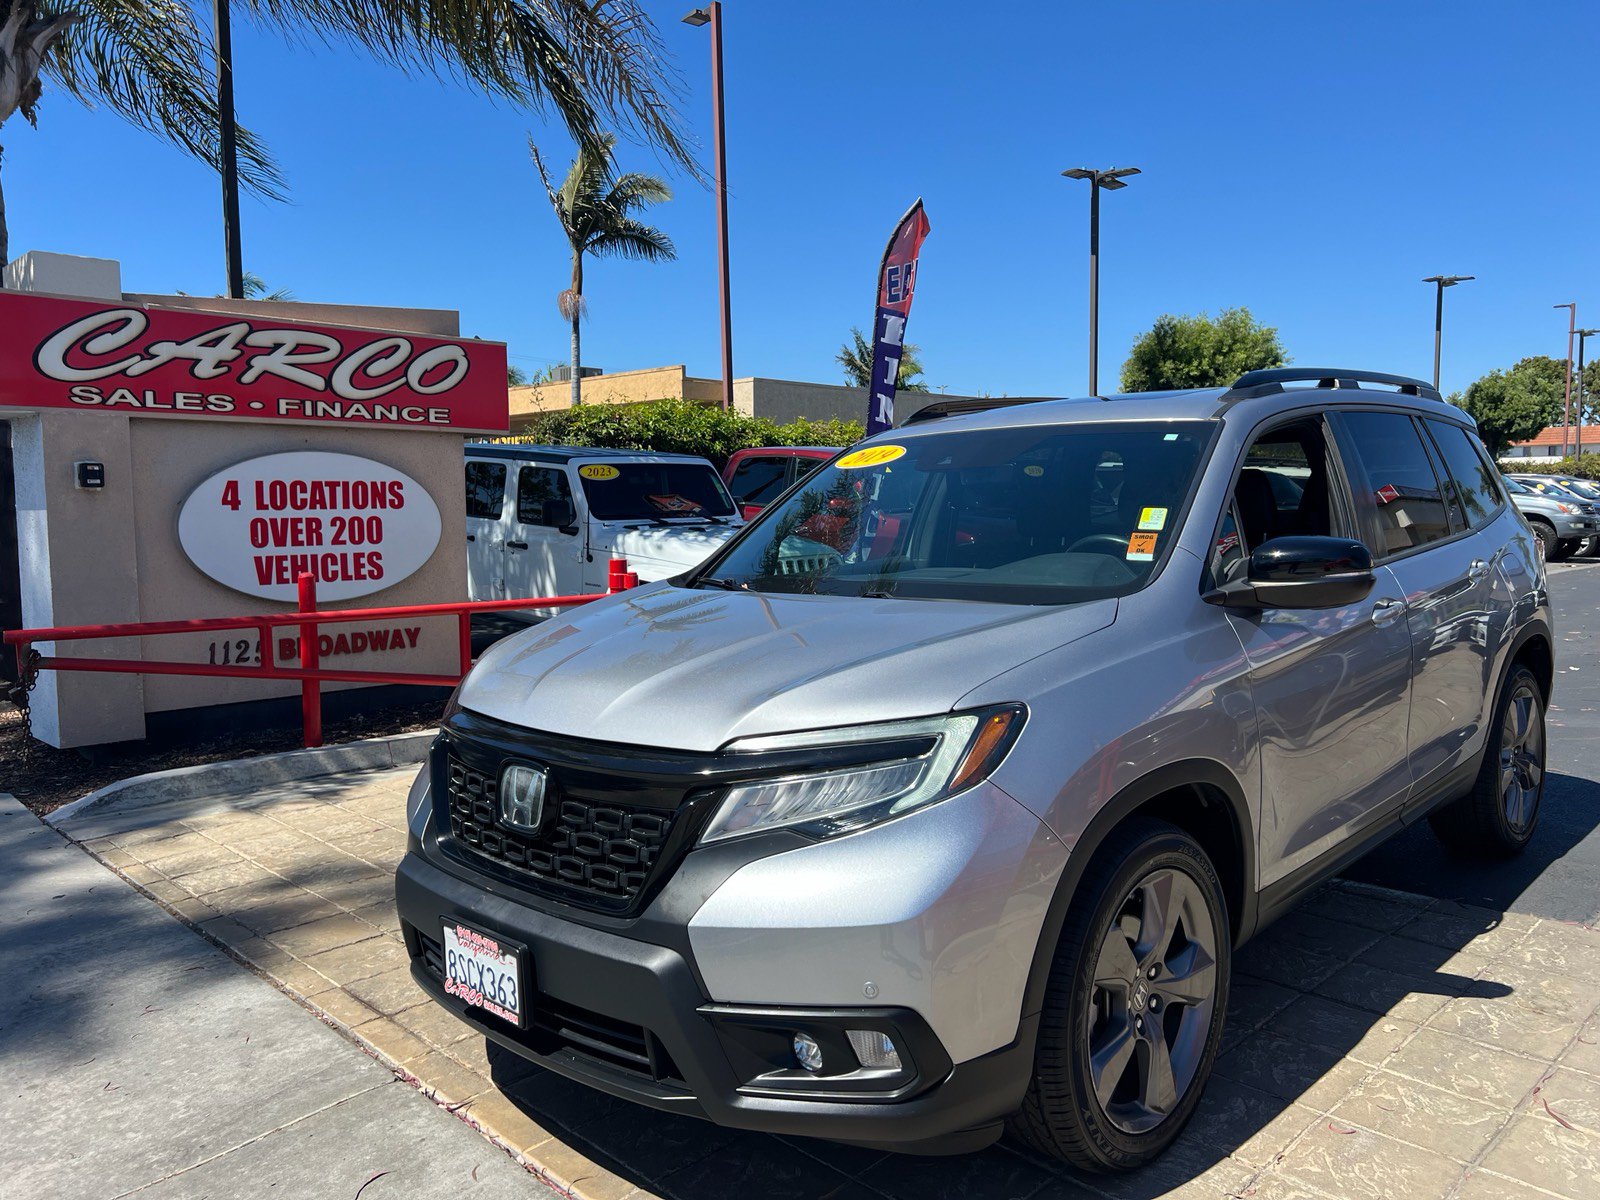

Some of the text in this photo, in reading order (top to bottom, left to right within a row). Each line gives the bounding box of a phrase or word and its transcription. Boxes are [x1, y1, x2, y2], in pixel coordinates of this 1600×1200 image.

[35, 308, 472, 400] CARCO
[70, 385, 451, 425] SALES FINANCE
[587, 467, 612, 477] 2023
[221, 480, 405, 511] 4 LOCATIONS
[250, 515, 383, 549] OVER 200
[254, 551, 384, 586] VEHICLES
[278, 627, 422, 661] BOADWAY
[444, 977, 484, 1007] CARCO
[448, 948, 518, 1011] 8SCX363
